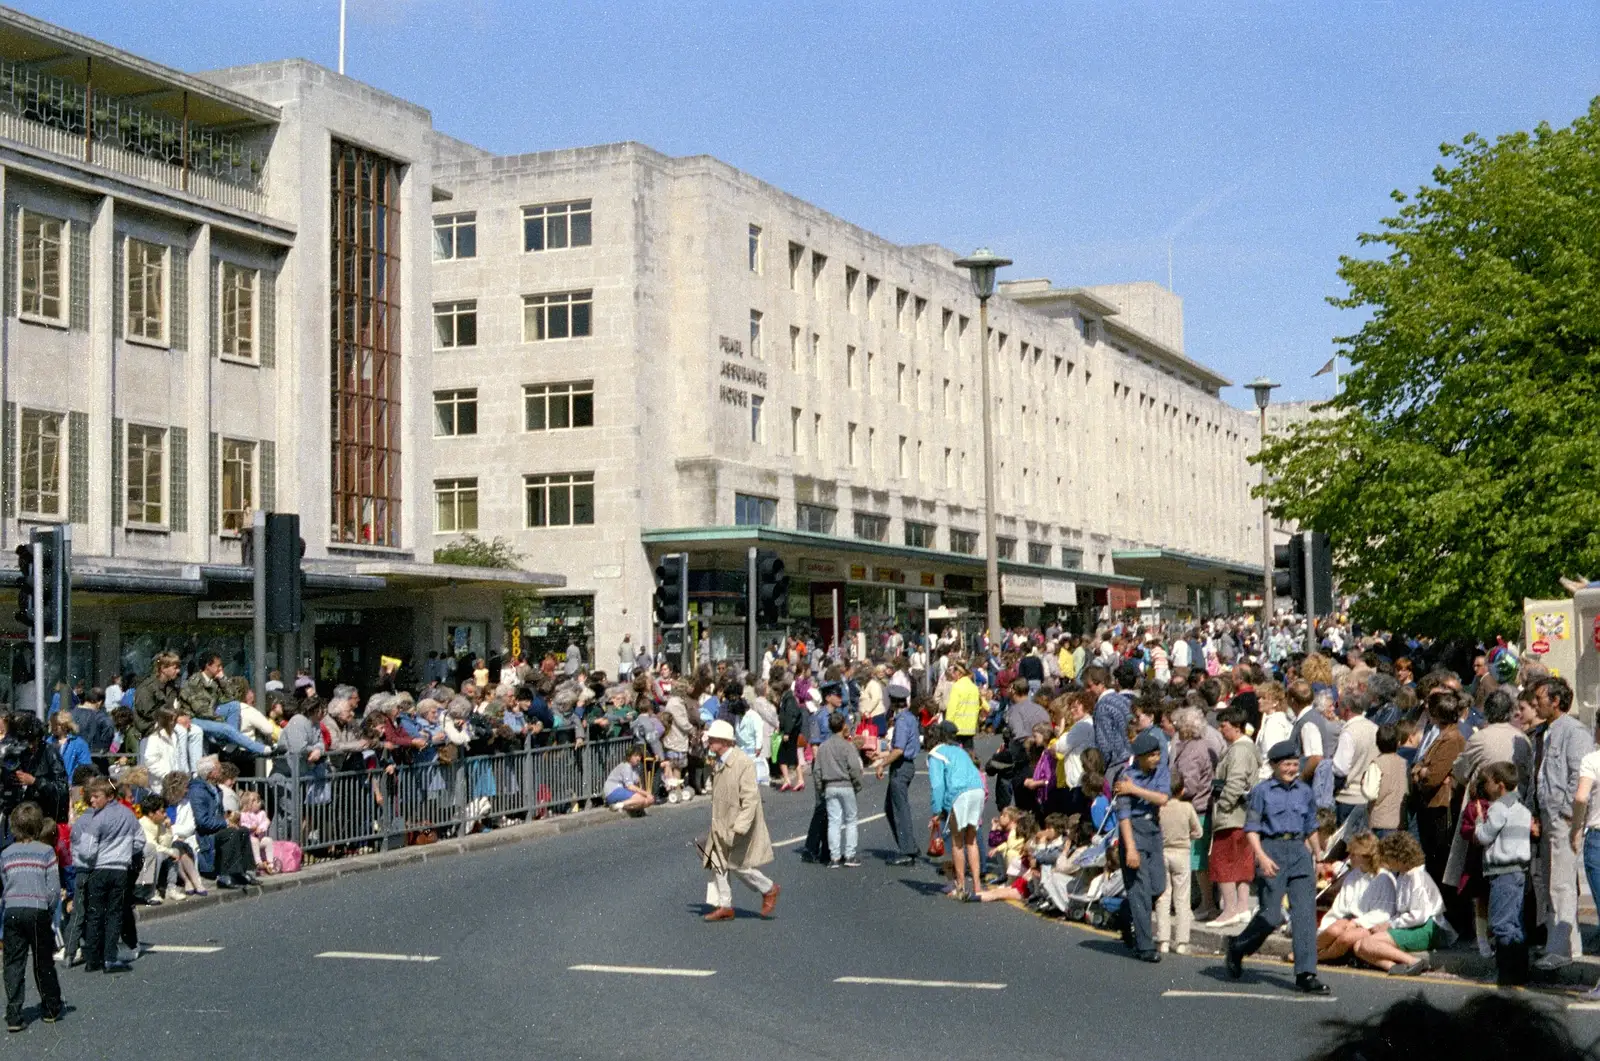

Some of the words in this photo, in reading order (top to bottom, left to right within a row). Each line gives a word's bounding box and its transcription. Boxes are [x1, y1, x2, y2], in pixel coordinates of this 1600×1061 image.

[719, 335, 743, 358] PEARL
[720, 360, 767, 389] ASSURANCE
[720, 384, 748, 408] HOUSE
